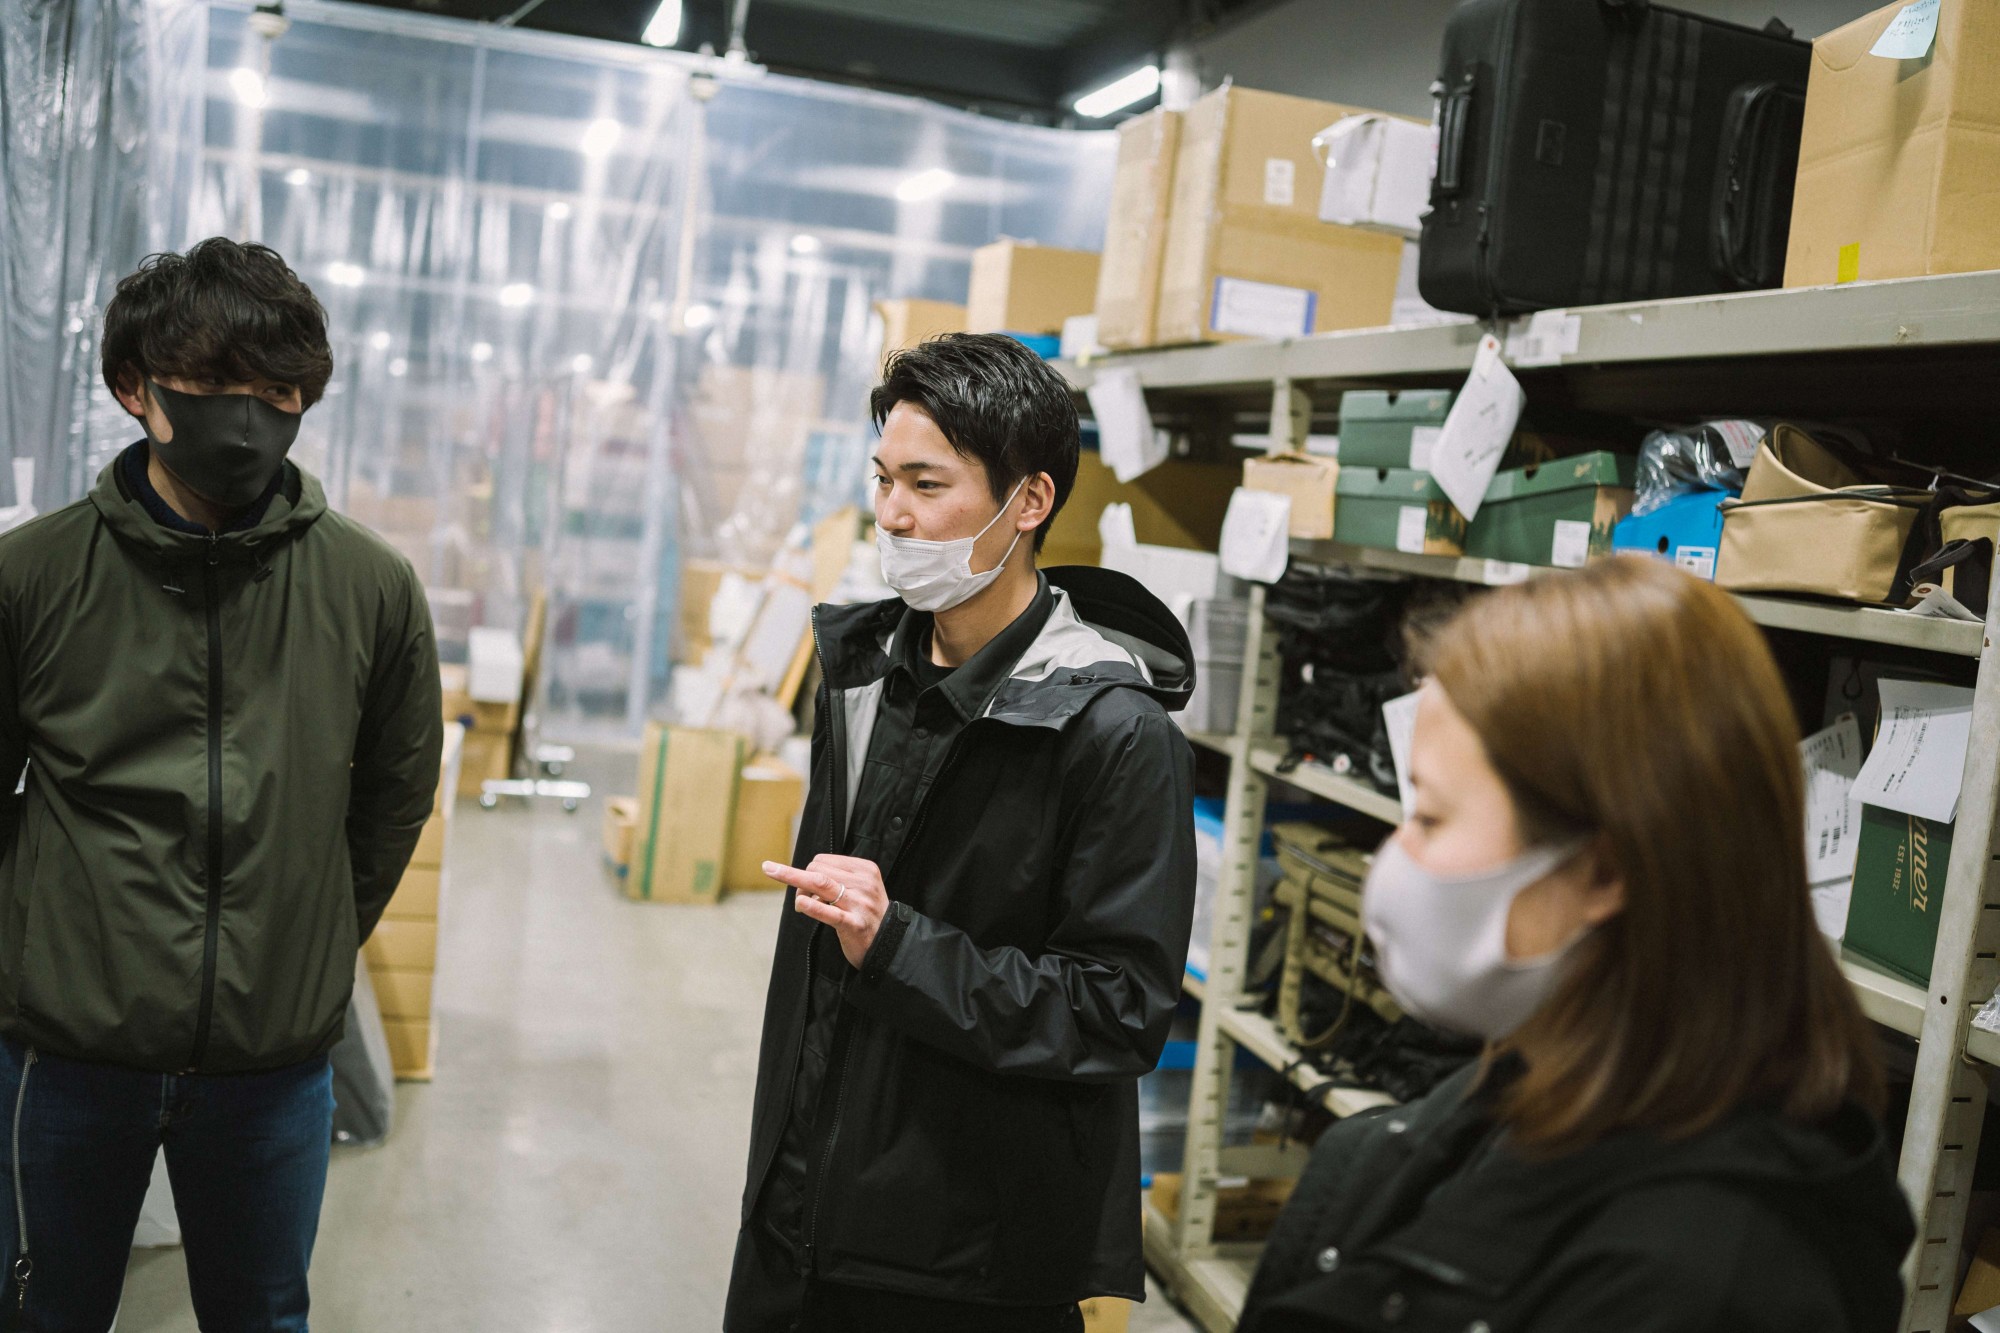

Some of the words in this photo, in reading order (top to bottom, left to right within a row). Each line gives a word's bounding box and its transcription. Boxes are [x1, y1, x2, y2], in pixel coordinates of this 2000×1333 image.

[1896, 844, 1906, 864] EST.
[1914, 817, 1928, 912] nner
[1892, 868, 1902, 890] 1932
